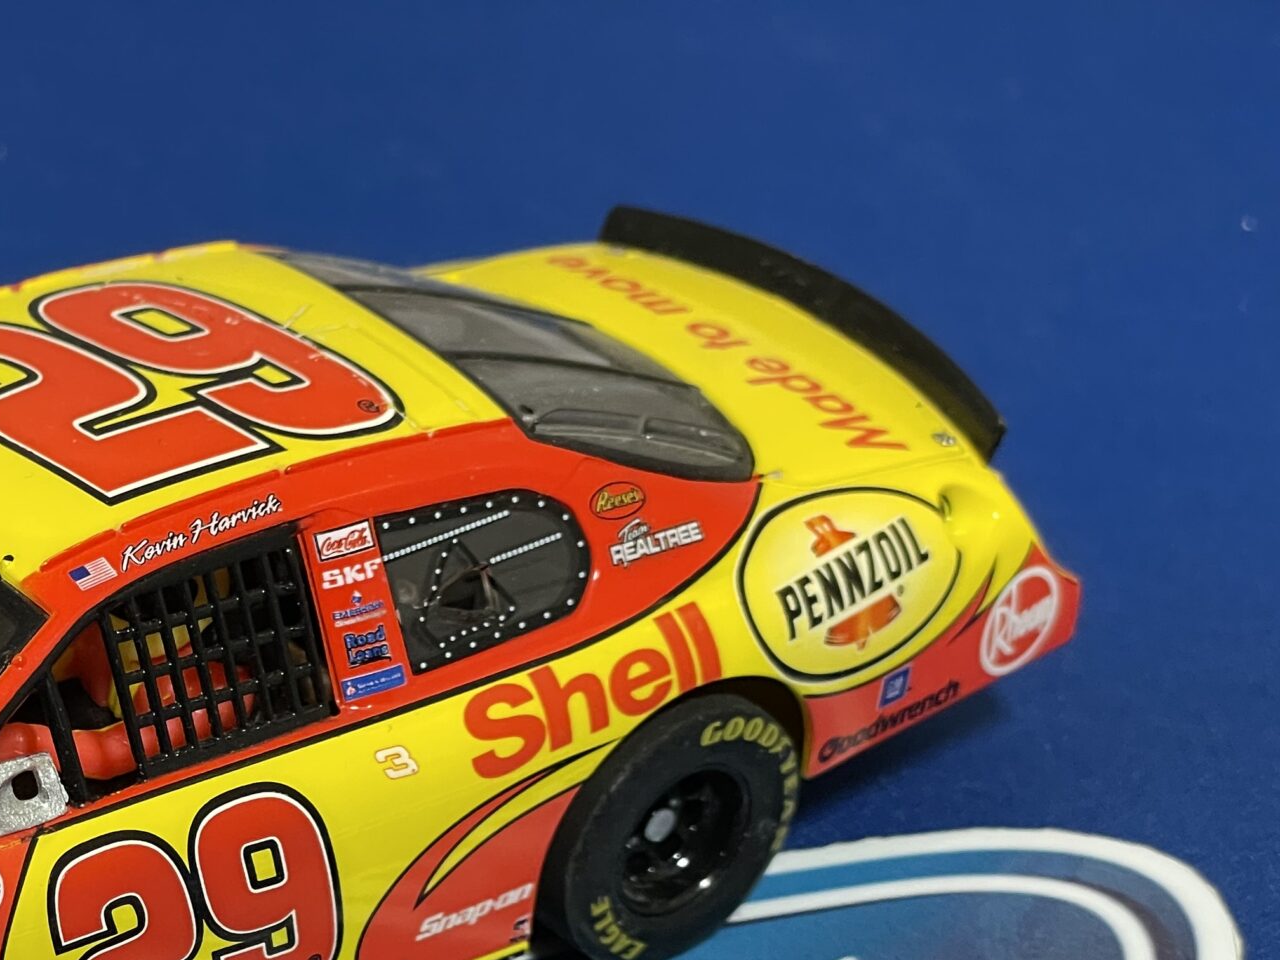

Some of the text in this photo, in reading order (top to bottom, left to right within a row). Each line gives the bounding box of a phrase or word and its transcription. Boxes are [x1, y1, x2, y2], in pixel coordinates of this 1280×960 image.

[546, 255, 910, 450] Made to move
[190, 494, 280, 543] Harvick
[610, 521, 703, 567] REALTREE
[322, 557, 382, 589] SKF
[775, 517, 929, 641] PENNZOIL
[344, 625, 386, 648] Road
[464, 601, 721, 780] Shell
[374, 745, 419, 780] 3
[590, 896, 649, 960] EAGLE
